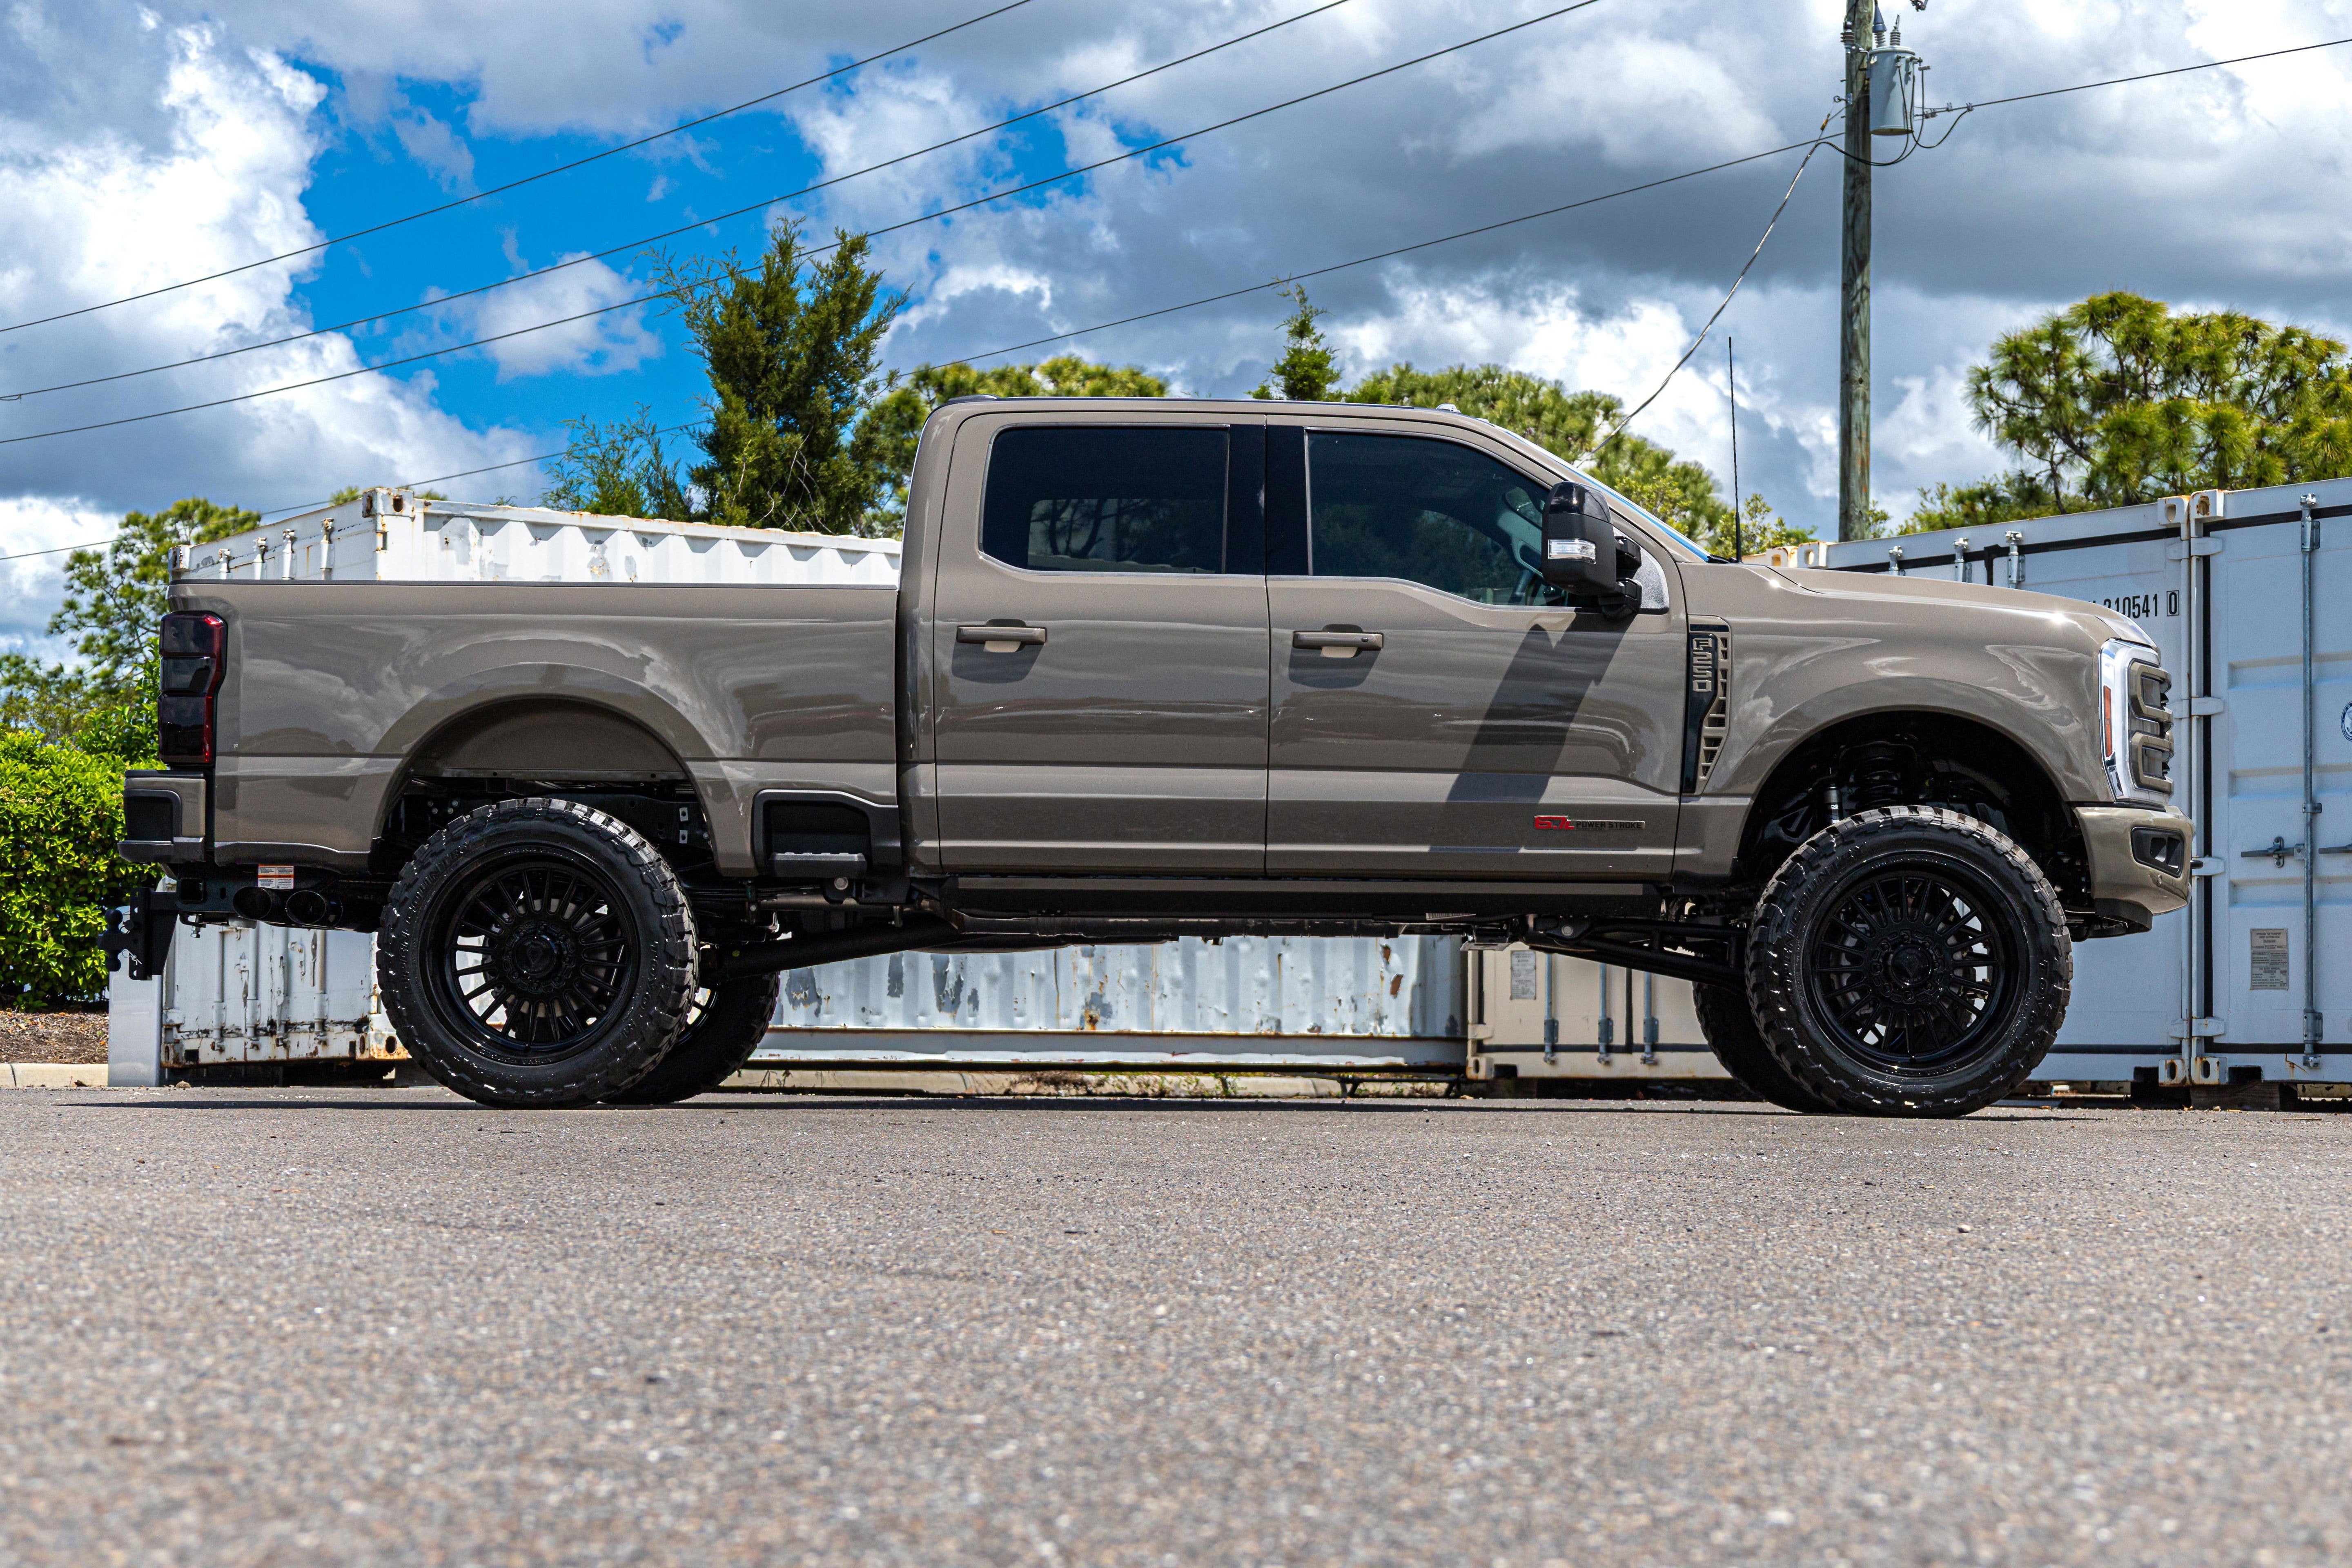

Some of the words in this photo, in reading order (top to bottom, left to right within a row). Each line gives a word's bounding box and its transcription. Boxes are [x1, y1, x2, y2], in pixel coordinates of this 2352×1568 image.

[2167, 591, 2178, 616] 0
[1693, 638, 1712, 692] F250
[1534, 816, 1575, 829] 6.7L
